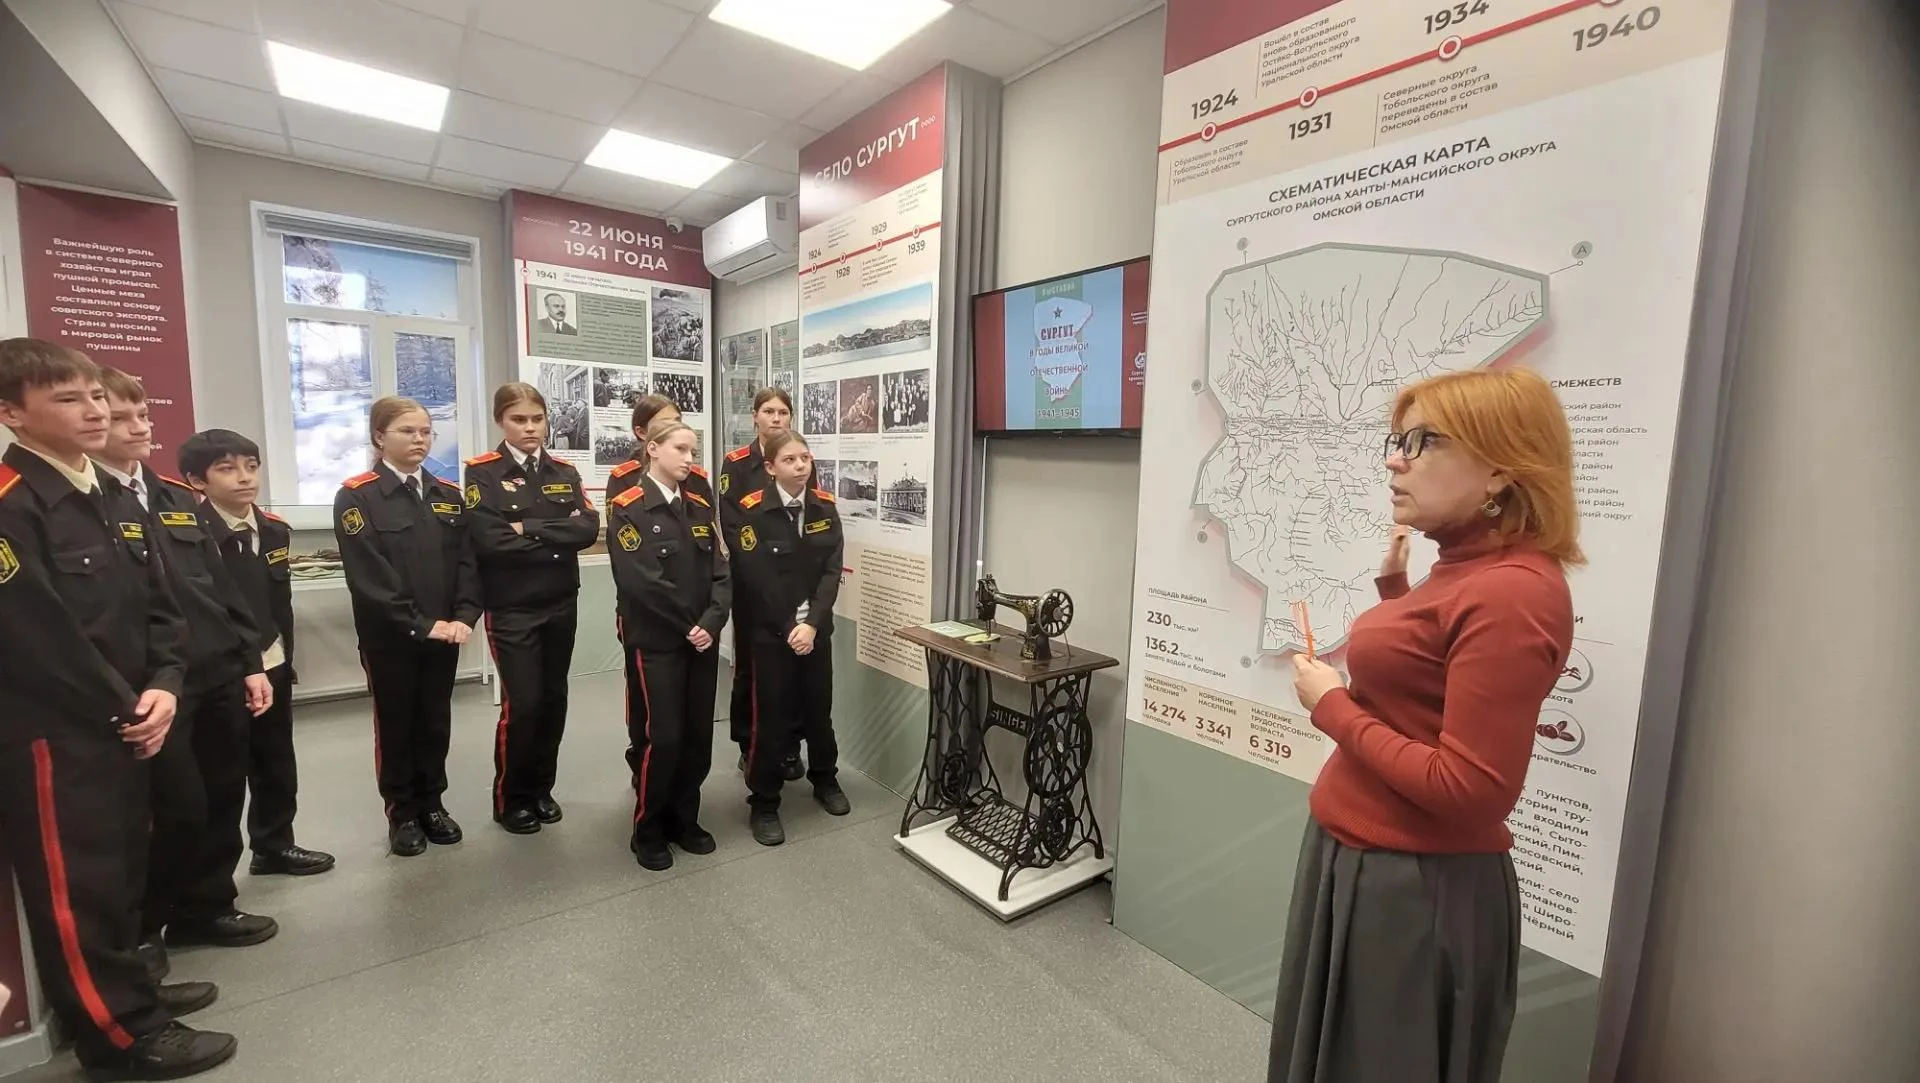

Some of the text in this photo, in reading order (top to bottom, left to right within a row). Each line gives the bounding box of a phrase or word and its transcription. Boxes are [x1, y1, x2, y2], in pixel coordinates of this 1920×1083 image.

[1423, 0, 1490, 35] 1934
[1264, 33, 1292, 49] Вошёл
[1300, 17, 1329, 34] состав
[1572, 5, 1661, 51] 1940
[1263, 16, 1357, 59] вновь образованного
[1261, 36, 1360, 78] национального округа
[1306, 52, 1343, 71] области
[1383, 65, 1478, 101] Северные округа
[1382, 73, 1490, 112] Тобольского округа
[1191, 88, 1239, 120] 1924
[1381, 82, 1499, 123] переведены в состав
[1288, 111, 1332, 140] 1931
[1380, 103, 1468, 134] Омской области
[814, 116, 920, 188] СЕЛО СУРГУТ
[1210, 160, 1241, 174] области
[1269, 136, 1491, 203] СХЕМАТИЧЕСКАЯ КАРТА
[1226, 140, 1557, 227] СУРГУТСКОГО РАЙОНА ХАНТЫ-МАНСИЙСКОГО ОКРУГА
[1312, 188, 1425, 221] ОМСКОЙ ОБЛАСТИ
[568, 219, 664, 250] 22 ИЮНЯ
[871, 221, 888, 236] 1929
[53, 237, 155, 257] Важнейшую роль
[564, 240, 668, 272] 1941 ГОДА
[908, 240, 926, 256] 1939
[55, 250, 103, 261] системе
[106, 256, 164, 269] северного
[60, 262, 152, 278] хозяйства играл
[536, 269, 557, 281] 1941
[836, 266, 851, 279] 1928
[53, 272, 160, 290] пушной промысел.
[71, 284, 146, 299] Ценные меха
[55, 295, 161, 312] составляли основу
[50, 306, 168, 322] советского экспорта.
[64, 318, 157, 332] Страна вносила
[1040, 324, 1074, 341] СУРГУТ
[71, 330, 124, 341] мировой
[126, 334, 163, 343] рынок
[86, 342, 141, 352] пушнины
[1035, 345, 1055, 357] ГОДЫ
[1055, 342, 1089, 355] ВЕЛИКОЙ
[1029, 363, 1089, 377] ОТЕЧЕСТВЕННОЙ
[1550, 377, 1622, 389] СМЕЖЕСТВ
[1589, 402, 1622, 411] район
[1567, 414, 1608, 422] области
[1605, 425, 1648, 434] область
[1587, 439, 1619, 447] район
[1581, 463, 1613, 471] район
[1587, 487, 1619, 495] район
[1593, 499, 1625, 508] район
[1603, 512, 1632, 521] округ
[1148, 587, 1207, 604] ПЛОЩАДЬ РАЙОНА
[1146, 610, 1171, 627] 230
[1145, 636, 1179, 656] 136.2
[1166, 657, 1187, 668] водой
[1192, 664, 1226, 679] болотами
[1144, 675, 1188, 693] ЧИСЛЕННОСТЬ
[1144, 683, 1180, 698] НАСЕЛЕНИЯ
[1198, 691, 1234, 707] КОРЕННОЕ
[1198, 699, 1238, 716] НАСЕЛЕНИЕ
[1143, 698, 1188, 723] 14 274
[1251, 707, 1293, 725] НАСЕЛЕНИЕ
[1195, 716, 1232, 740] 3 341
[1250, 715, 1322, 742] ТРУДОСПОСОБНОГО
[1250, 722, 1285, 739] ВОЗРАСТА
[1195, 732, 1225, 747] человек
[1249, 734, 1292, 759] 6 319
[1248, 750, 1280, 765] человек
[1530, 752, 1597, 776] ирательство
[1536, 788, 1592, 812] пунктов,
[1520, 796, 1557, 814] гории
[1563, 809, 1591, 823] тру-
[1533, 813, 1589, 837] входили
[1548, 830, 1588, 849] Сыто-
[1513, 844, 1584, 876] косовский,
[1513, 857, 1546, 875] ский.
[1548, 887, 1580, 904] село
[1533, 905, 1576, 927] Широ-
